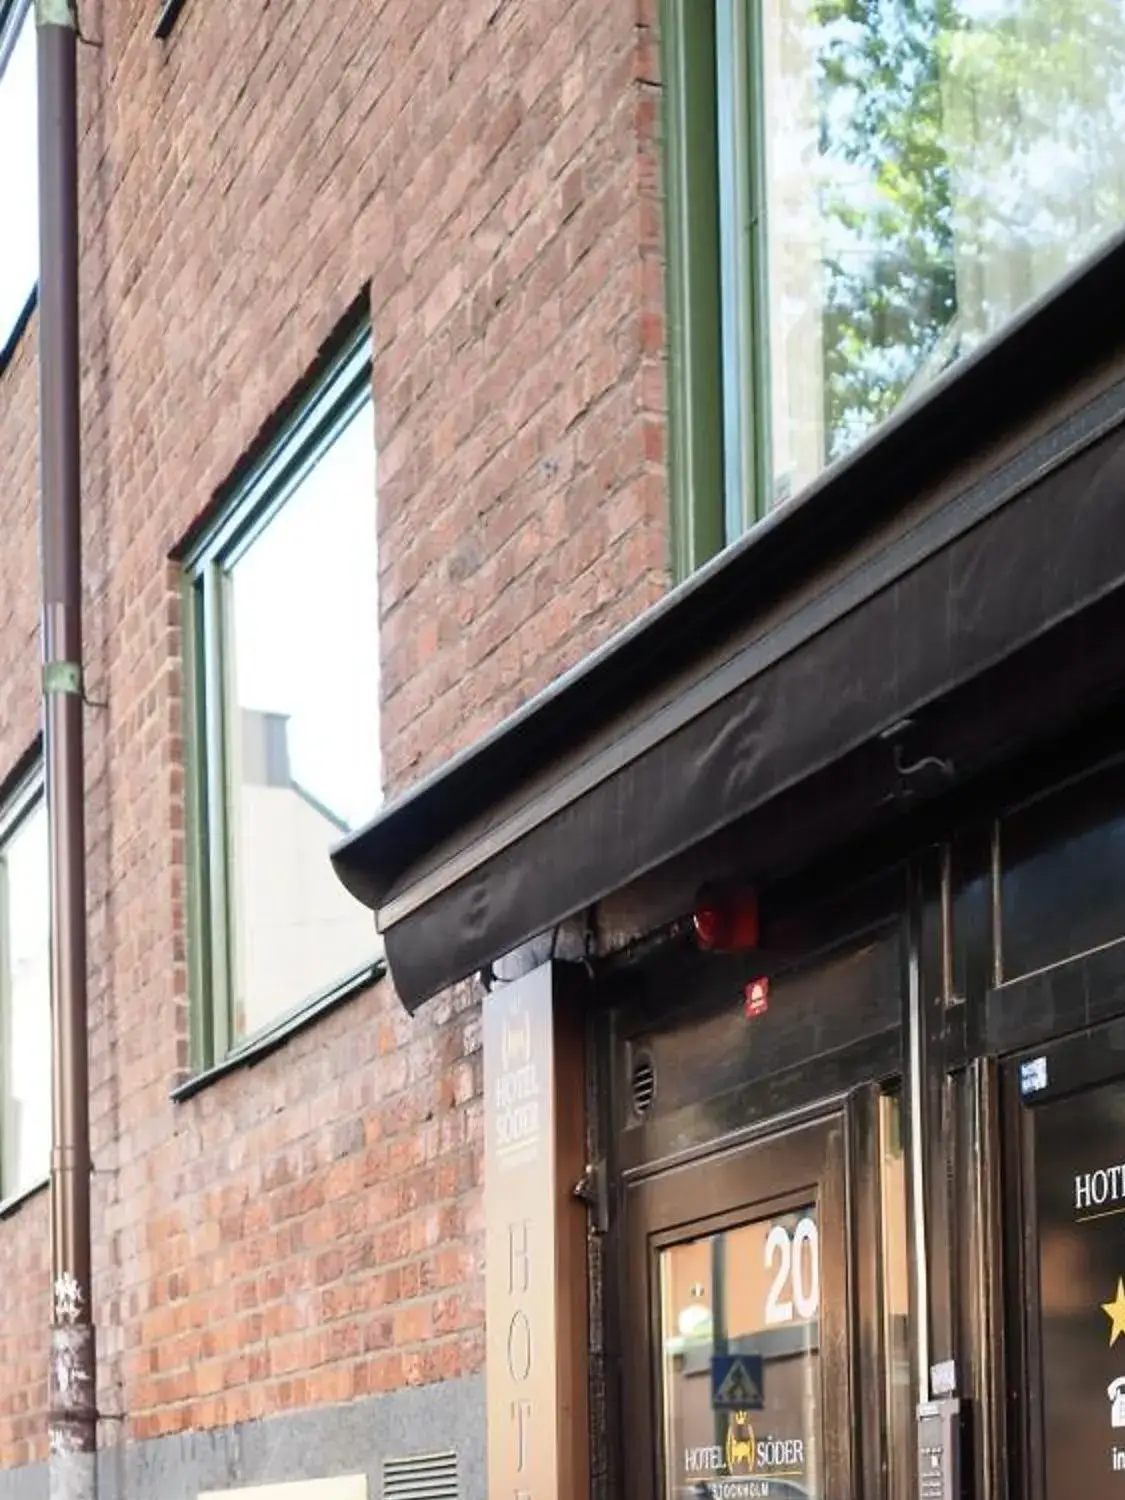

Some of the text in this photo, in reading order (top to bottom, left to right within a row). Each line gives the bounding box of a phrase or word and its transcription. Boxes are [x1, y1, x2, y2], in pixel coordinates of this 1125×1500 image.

[764, 1217, 819, 1326] 20
[685, 1434, 803, 1471] HOTEL SÖDER
[713, 1481, 769, 1500] STOCKHOLM
